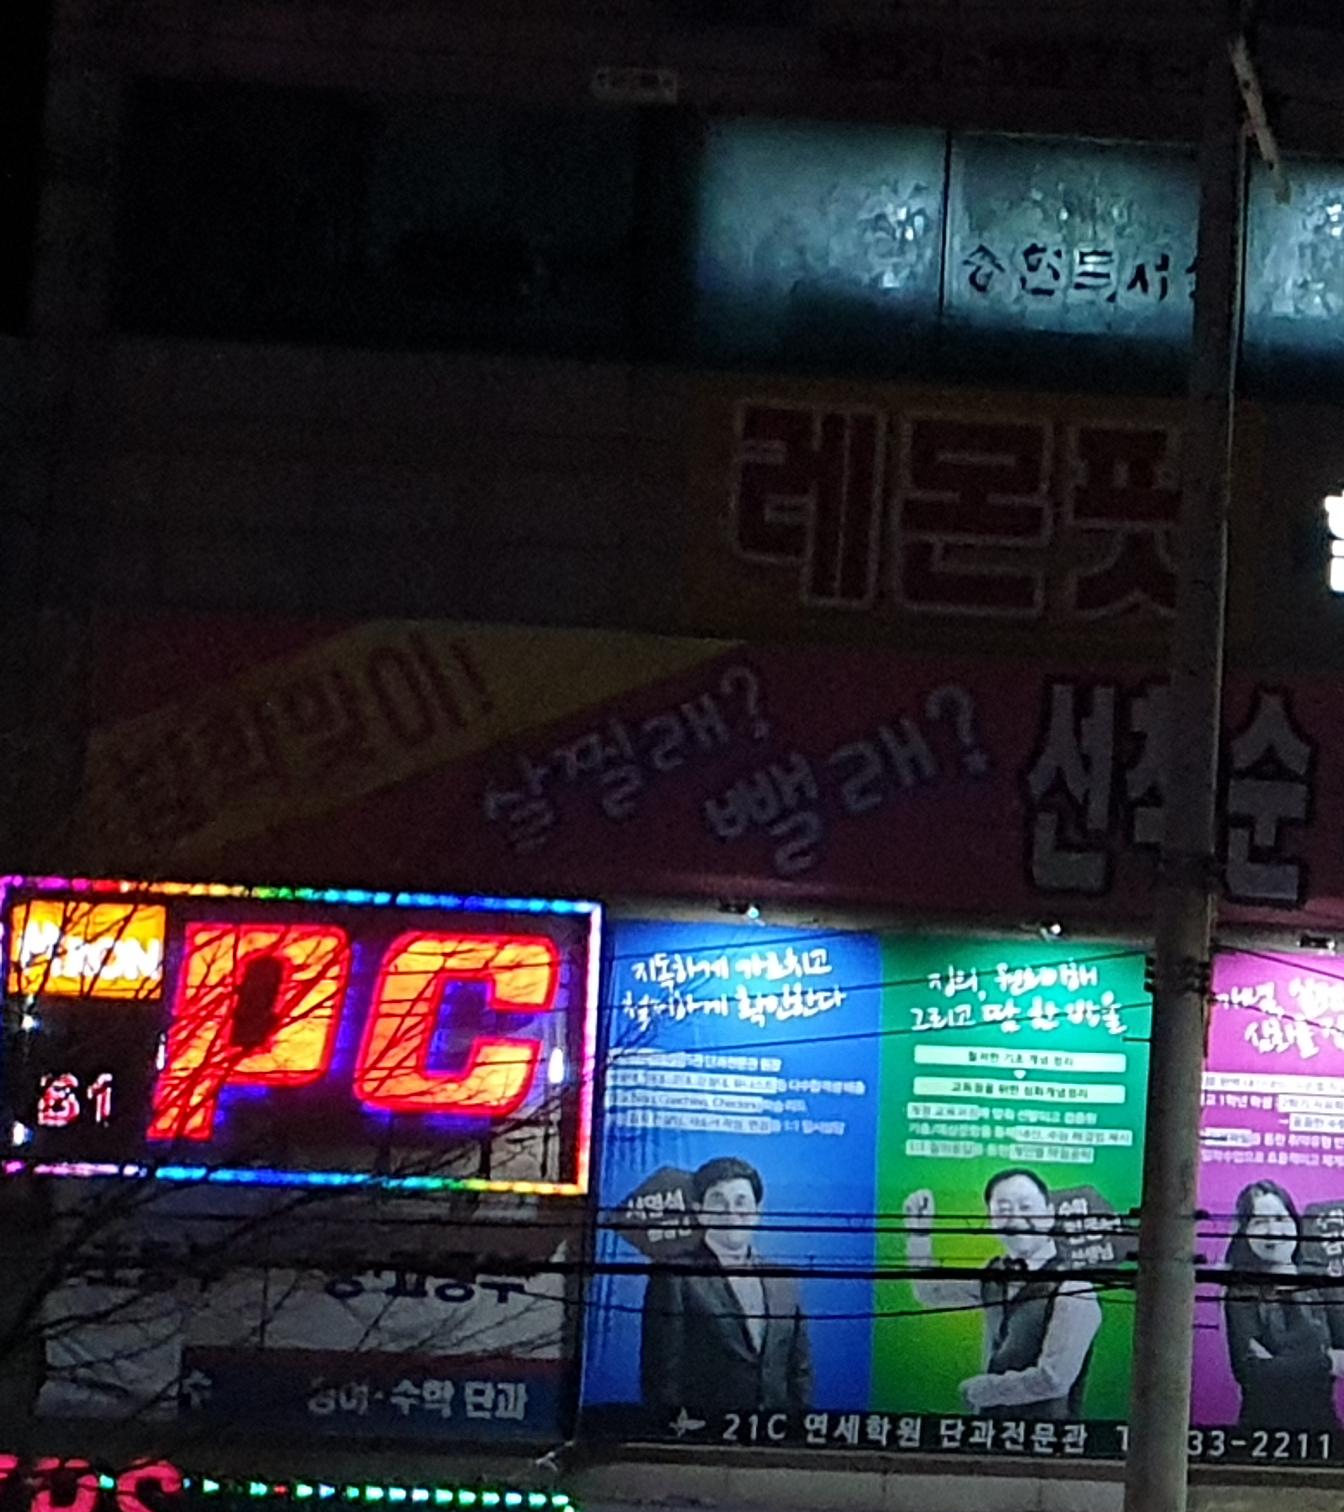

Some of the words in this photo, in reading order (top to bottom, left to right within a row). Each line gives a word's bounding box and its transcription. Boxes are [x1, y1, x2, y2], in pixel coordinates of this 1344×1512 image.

[146, 921, 561, 1142] PC
[910, 1003, 976, 1032] 그리고
[722, 1412, 788, 1441] 21C
[803, 1414, 922, 1448] 연세학원
[939, 1420, 1089, 1455] 단과전문관
[1185, 1429, 1333, 1460] 33-2211
